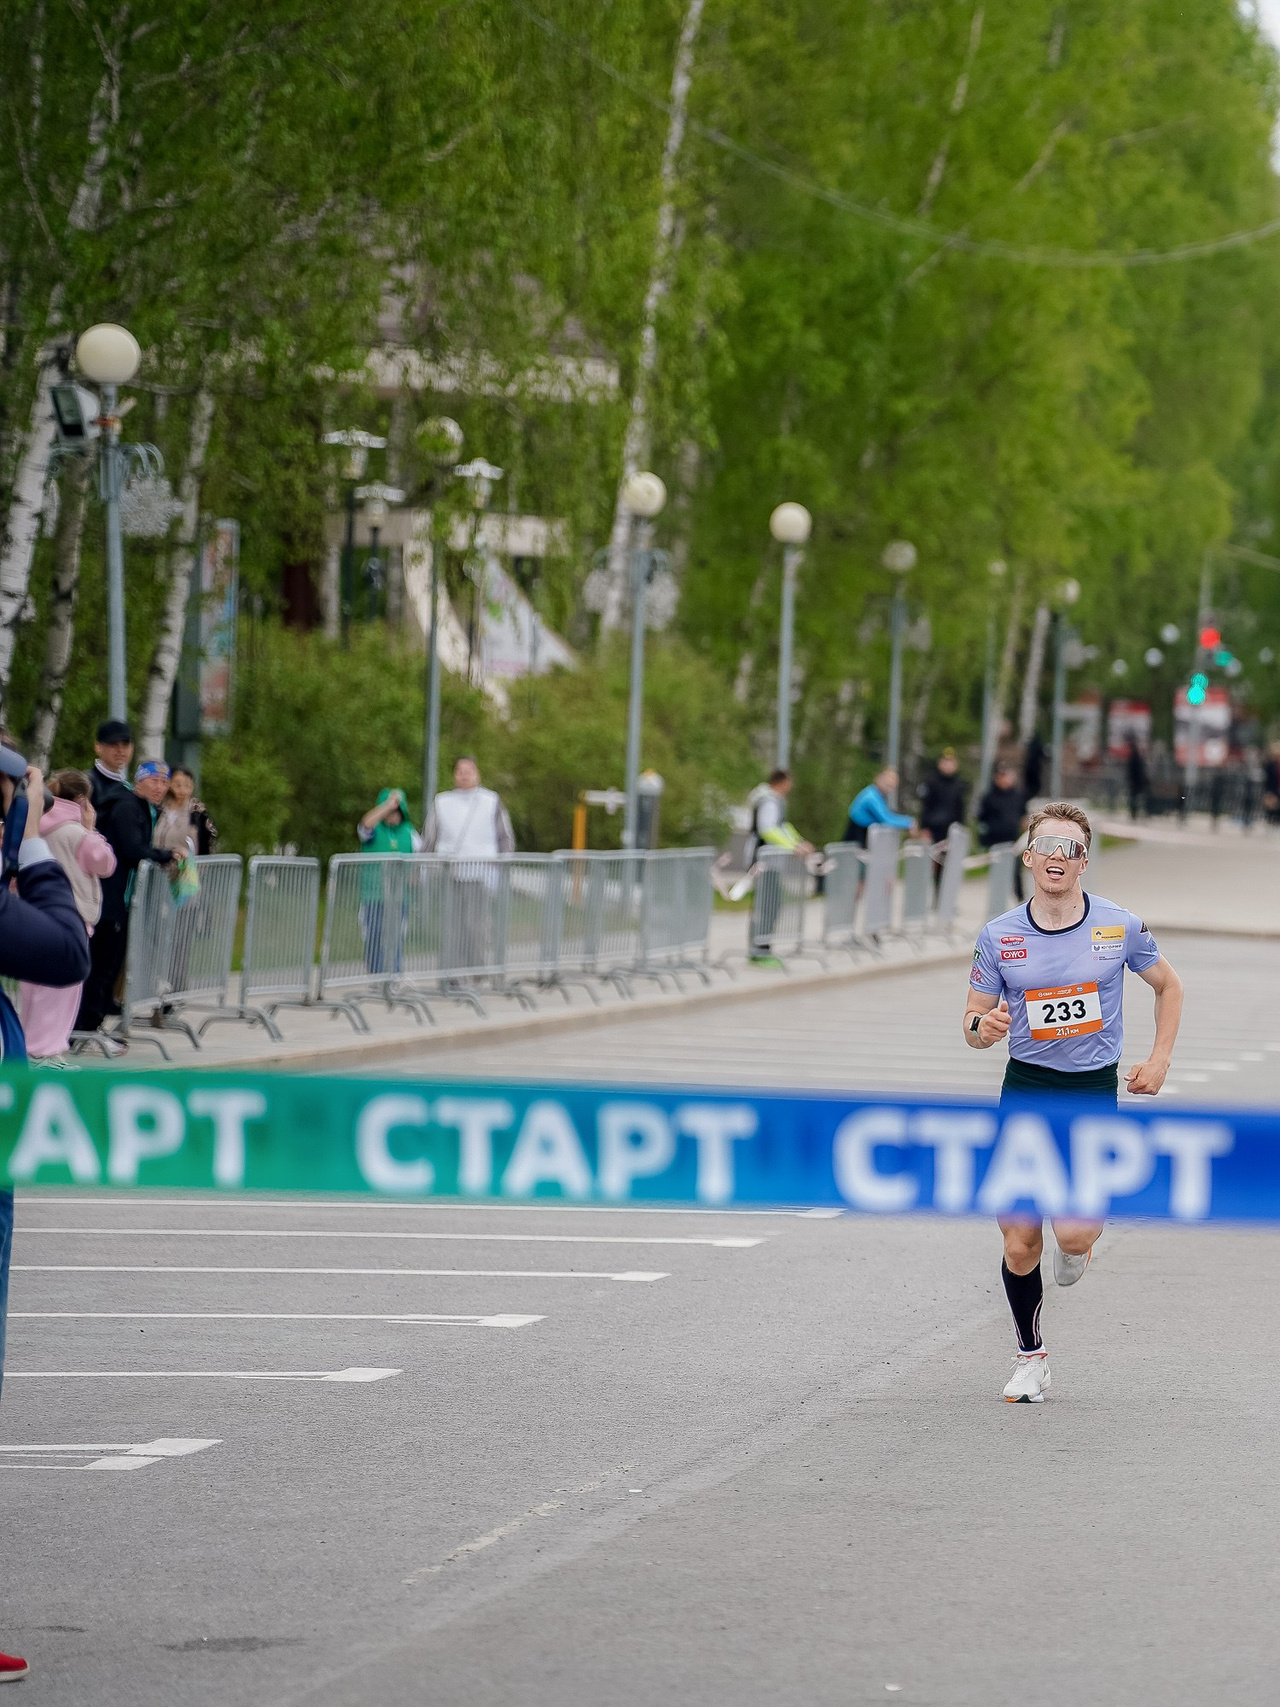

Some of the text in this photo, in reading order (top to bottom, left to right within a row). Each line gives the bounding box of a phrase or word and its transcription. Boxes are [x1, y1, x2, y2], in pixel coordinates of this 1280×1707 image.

[1042, 999, 1086, 1024] 233
[0, 1083, 266, 1187] АРТ
[355, 1093, 757, 1202] СТАРТ
[832, 1106, 1234, 1221] СТАРТ
